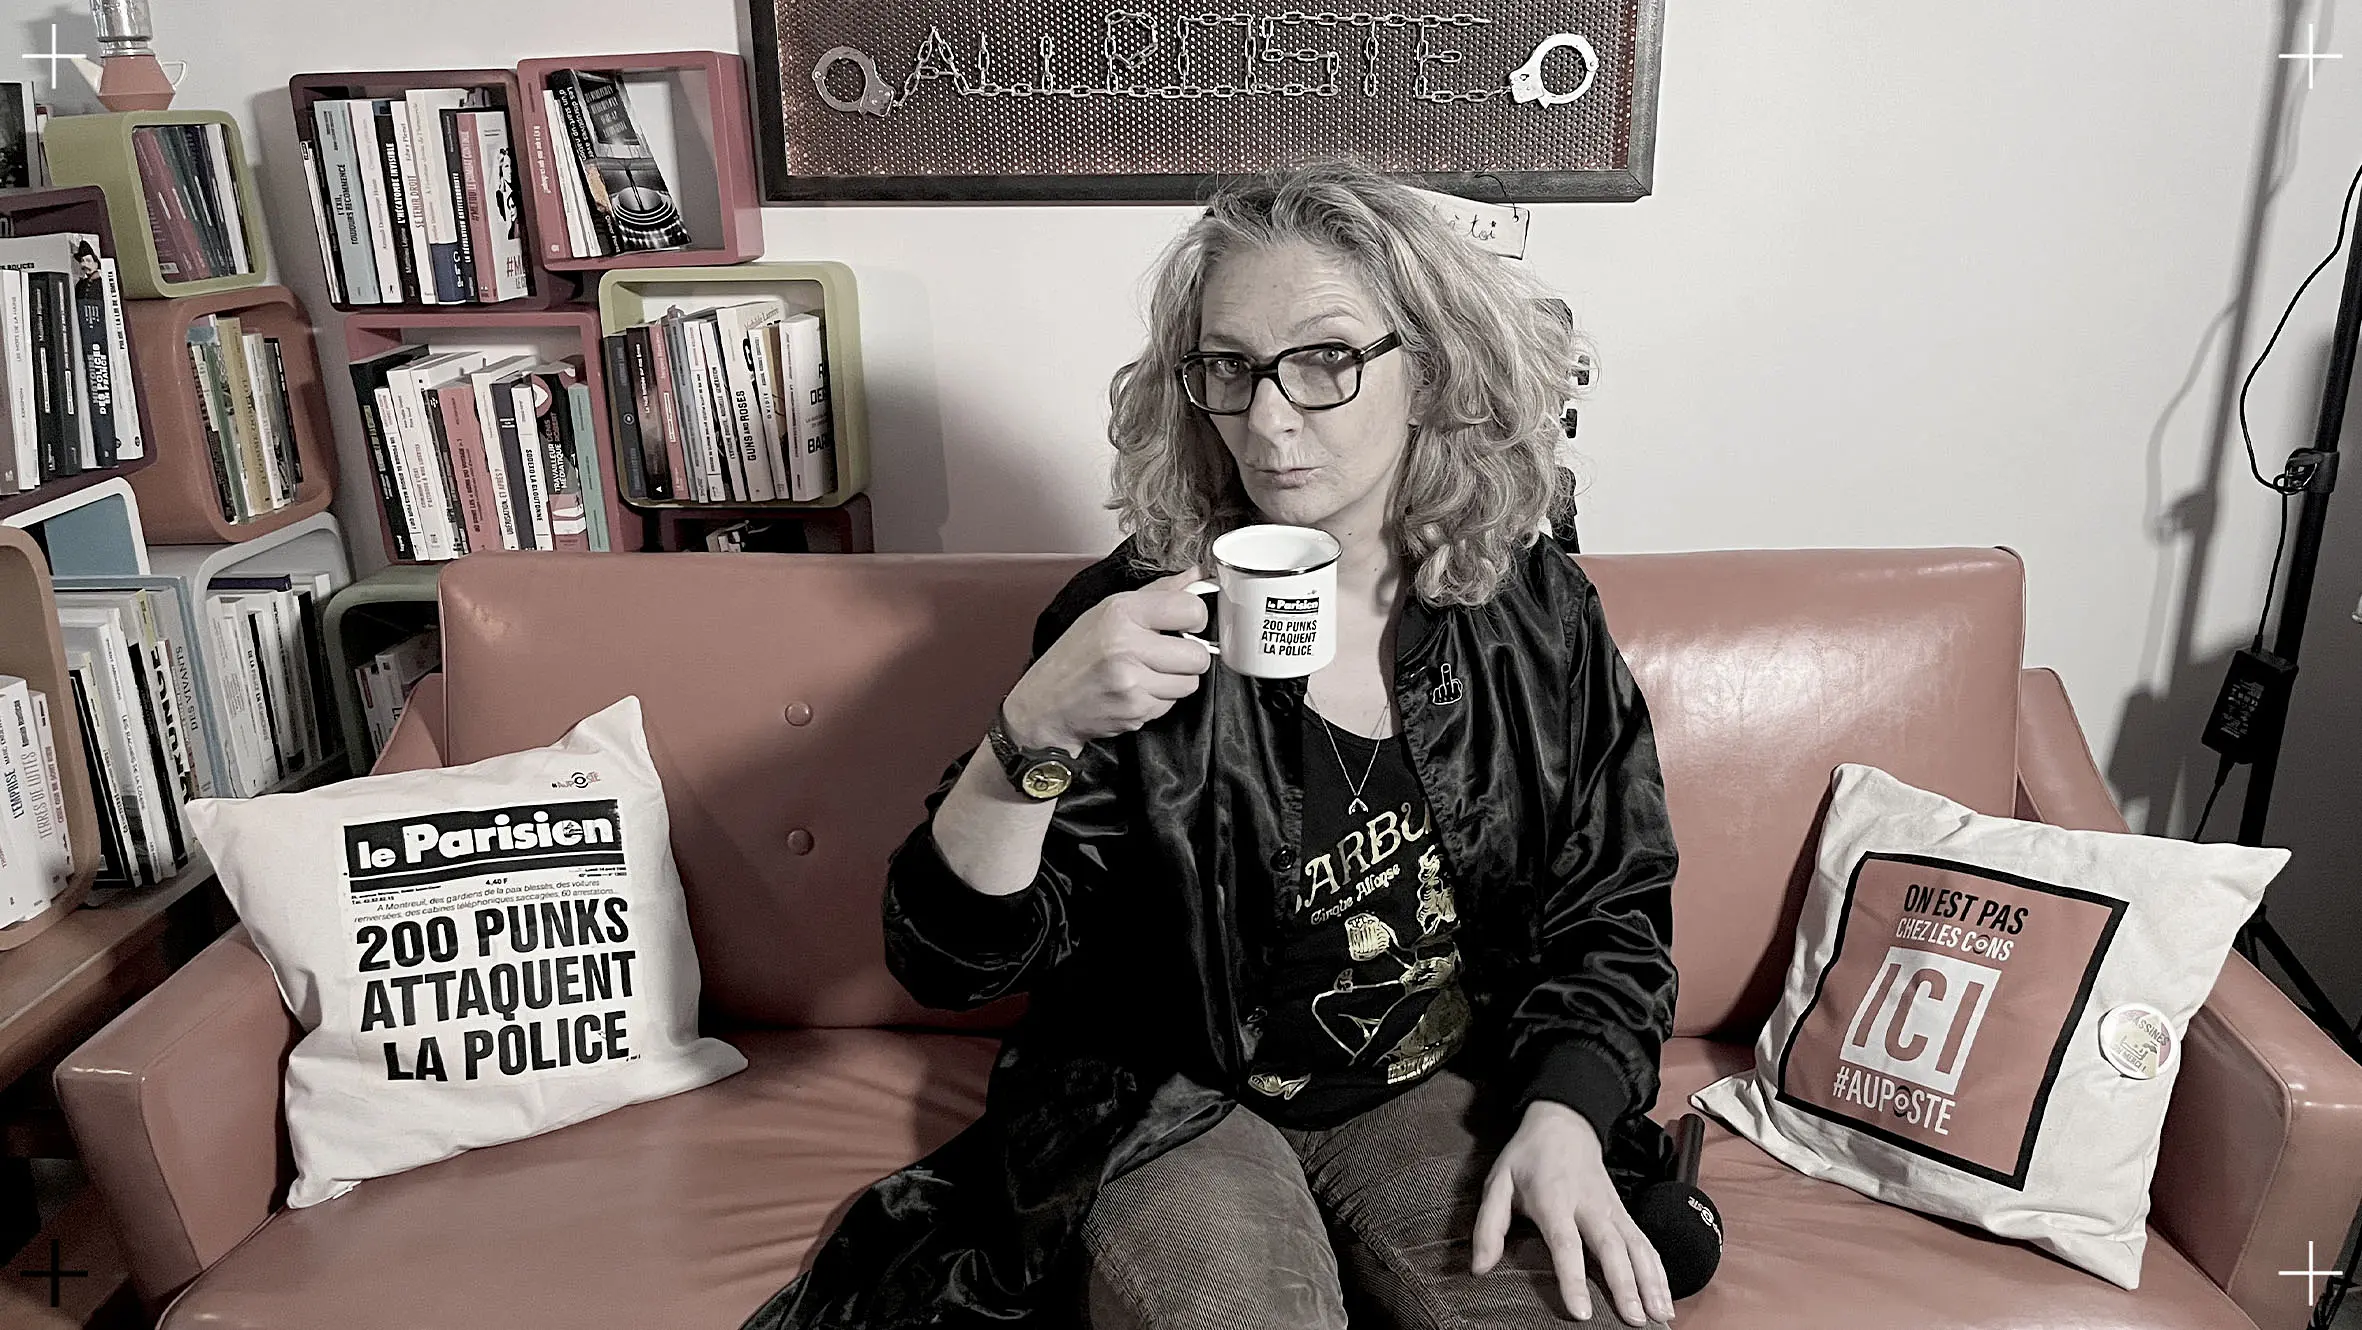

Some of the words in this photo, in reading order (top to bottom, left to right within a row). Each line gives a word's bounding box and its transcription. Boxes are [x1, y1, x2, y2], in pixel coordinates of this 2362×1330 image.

[386, 143, 398, 176] INVISIBLE
[87, 353, 99, 404] HISTOIRE
[93, 344, 104, 390] POLICES
[99, 355, 109, 390] FRANCE
[97, 393, 107, 414] DES
[736, 391, 749, 421] ROSES
[744, 436, 756, 461] GUNS
[530, 475, 537, 483] LA
[548, 444, 560, 492] TRAVAILLEUR
[1261, 630, 1317, 645] ATTAQUENT
[1262, 618, 1283, 631] 200
[1285, 619, 1317, 632] PUNKS
[1263, 642, 1275, 655] LA
[1278, 644, 1312, 656] POLICE
[176, 647, 191, 703] VIVANTS
[188, 706, 198, 730] DES
[22, 752, 41, 787] LUTTES
[4, 769, 24, 818] L'EMPRISE
[30, 789, 44, 801] DE
[34, 802, 52, 839] TERRES
[358, 841, 396, 869] le
[402, 811, 614, 864] Parisien
[1295, 798, 1433, 914] ARBU
[447, 892, 482, 903] gardiens
[572, 879, 599, 887] voitures
[422, 905, 454, 914] cabines
[1311, 896, 1353, 924] Cirque
[1904, 884, 1935, 915] ON
[1936, 890, 1978, 922] EST
[1976, 899, 2028, 935] PAS
[356, 916, 459, 972] 200
[475, 897, 629, 957] PUNKS
[1895, 918, 1929, 942] CHEZ
[1928, 923, 1958, 948] LES
[1962, 934, 2014, 961] CONS
[360, 950, 636, 1032] ATTAQUENT
[1852, 963, 1985, 1075] ICI
[383, 1036, 448, 1081] LA
[464, 1010, 630, 1081] POLICE
[1833, 1066, 1956, 1135] #AUPOSTE
